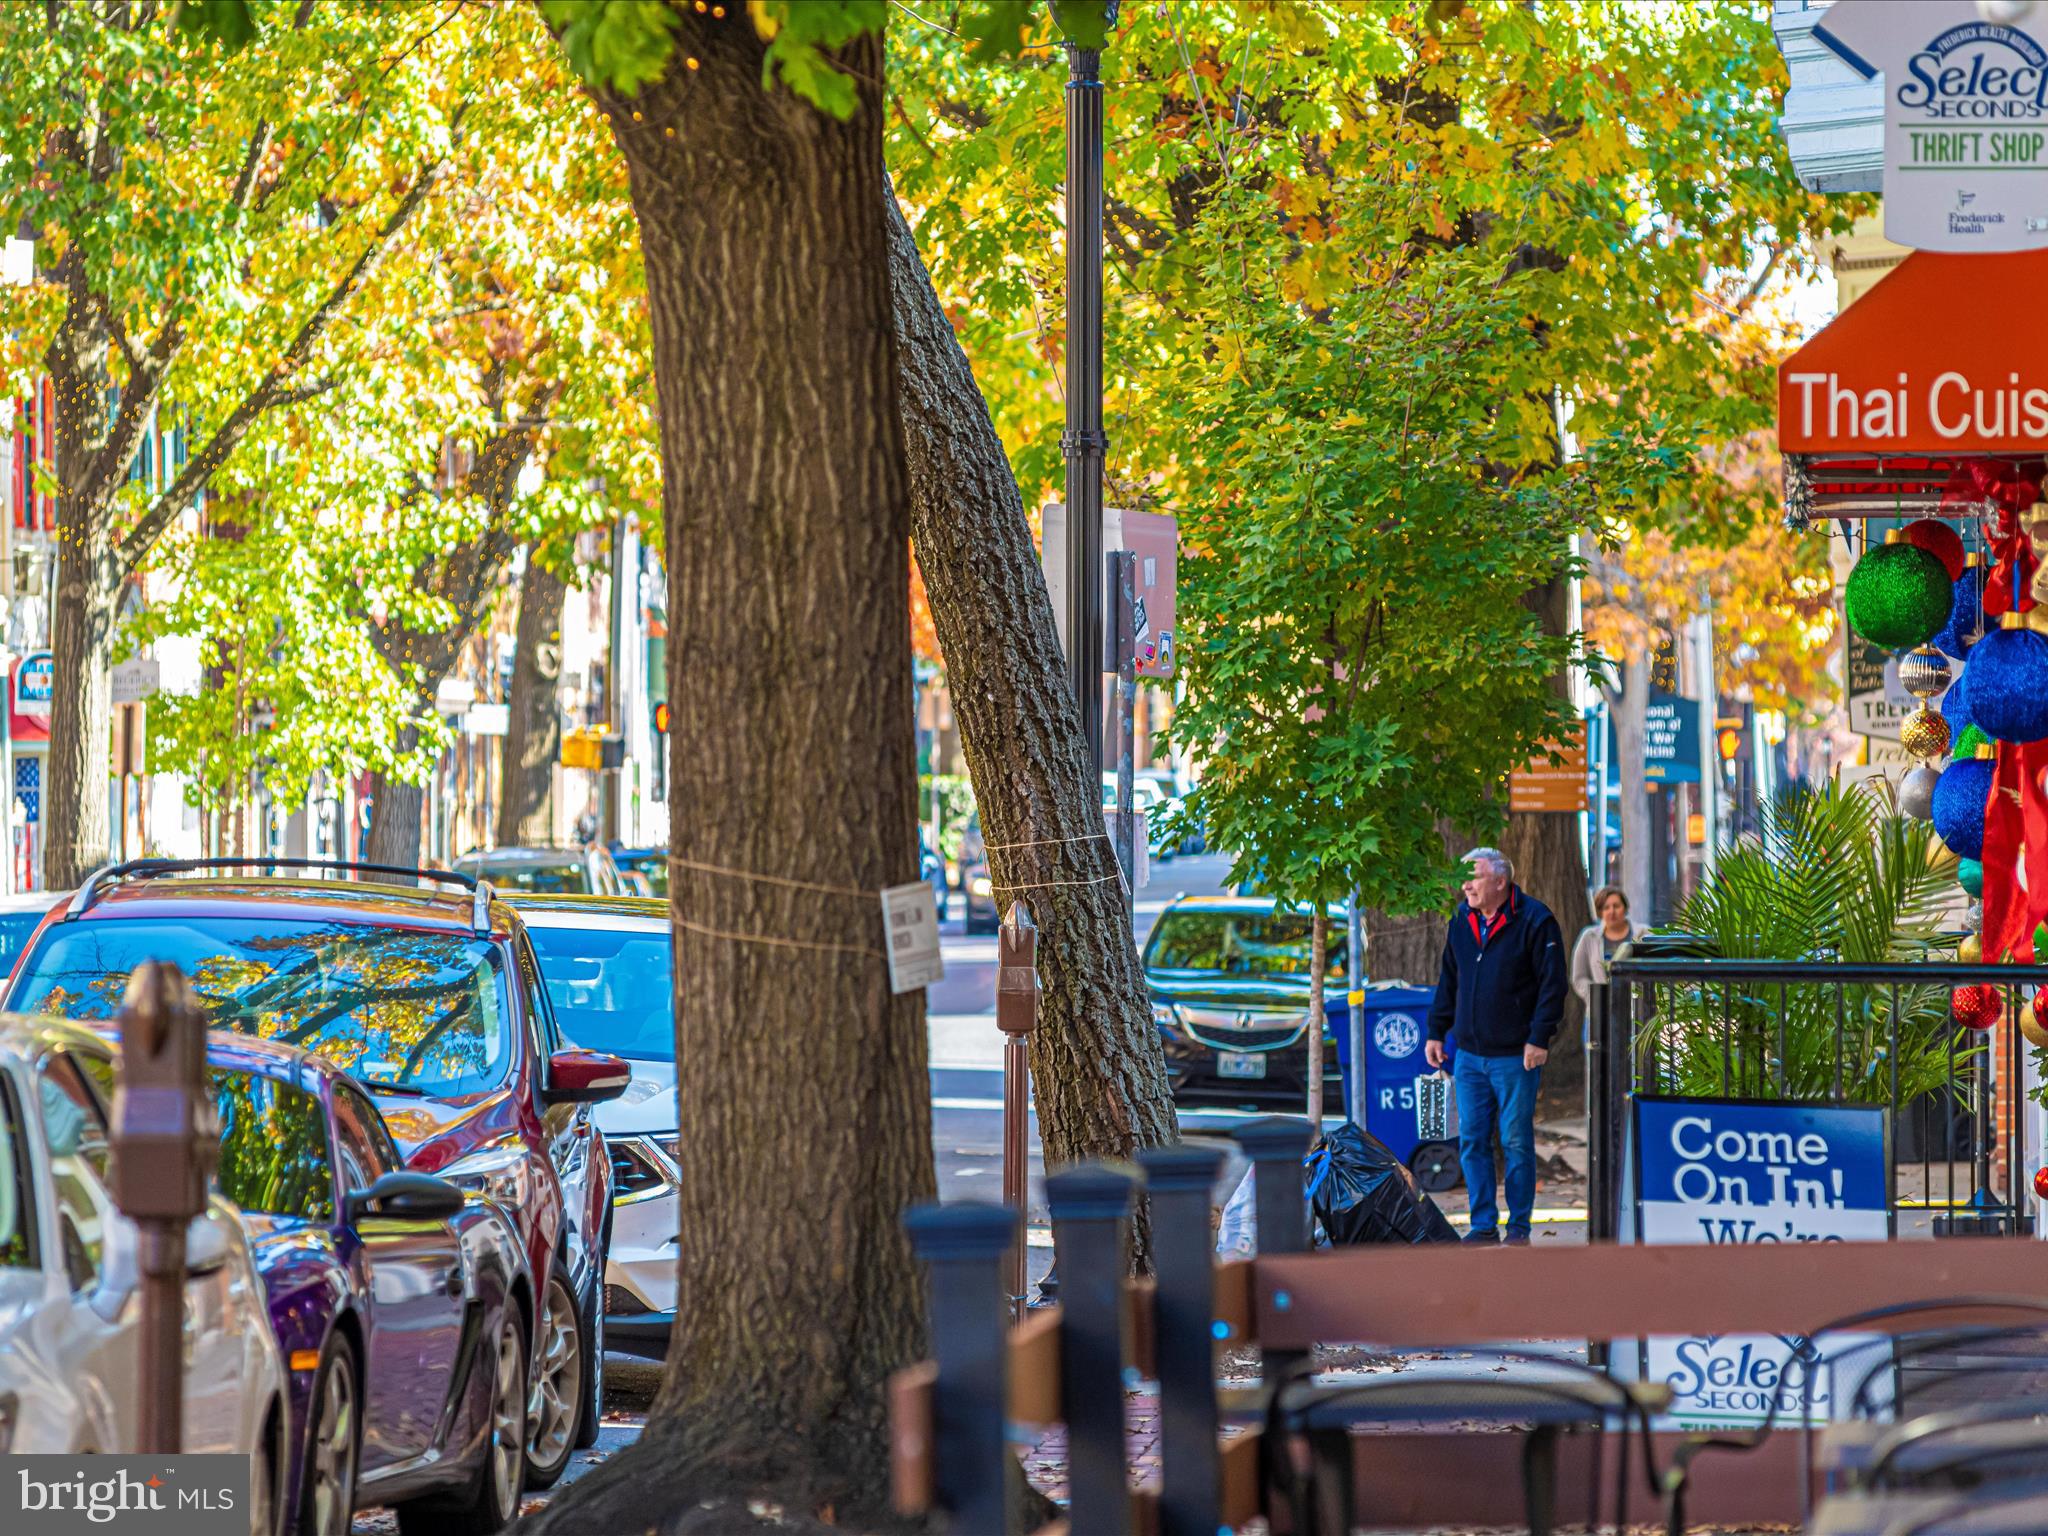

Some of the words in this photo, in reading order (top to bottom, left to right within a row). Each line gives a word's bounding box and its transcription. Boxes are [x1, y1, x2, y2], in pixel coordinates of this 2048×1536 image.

[1926, 100, 2042, 118] SECONDS
[1911, 132, 1983, 162] THRIFT
[1990, 132, 2045, 162] SHOP
[1949, 212, 2005, 223] Frederick
[1949, 223, 1985, 233] Health
[1788, 372, 1908, 438] Thai
[1930, 372, 2048, 438] Cuis
[1671, 1116, 1829, 1166] Come
[1674, 1163, 1753, 1206] On
[1767, 1166, 1845, 1209] In!
